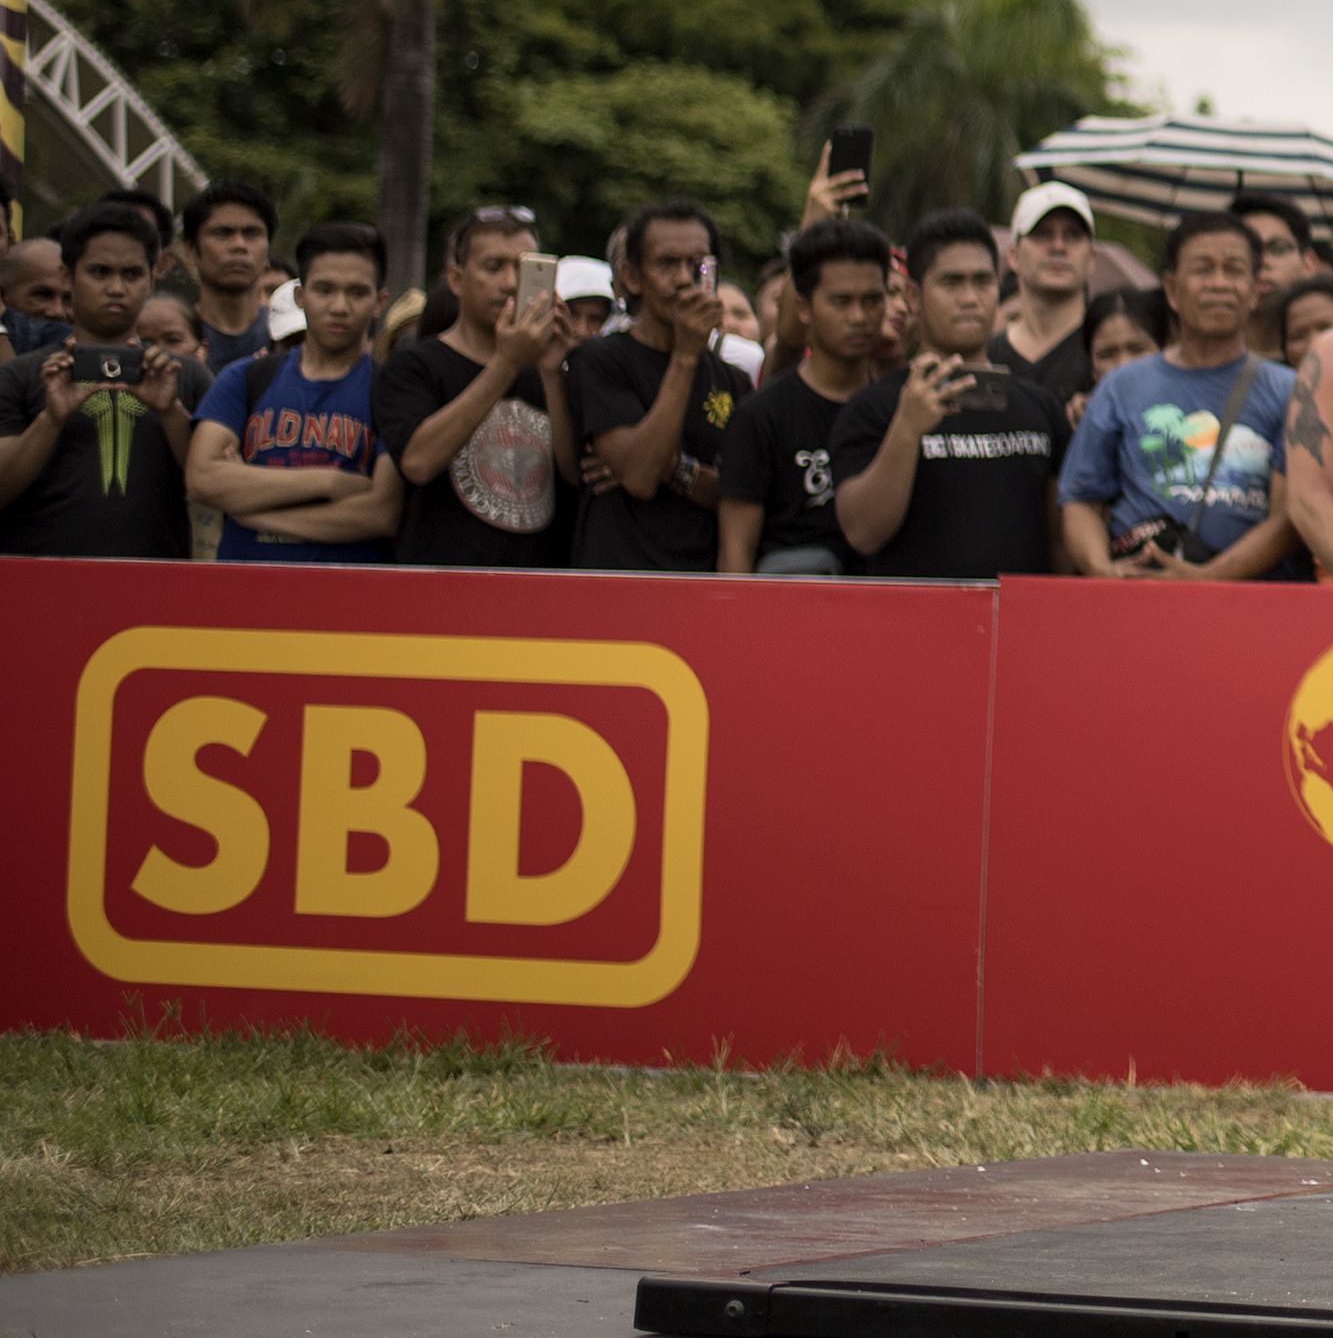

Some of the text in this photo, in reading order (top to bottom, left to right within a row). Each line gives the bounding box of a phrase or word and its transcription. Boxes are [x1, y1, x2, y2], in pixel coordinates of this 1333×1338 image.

[243, 407, 376, 474] OLD NAVY
[129, 695, 637, 927] SBD
